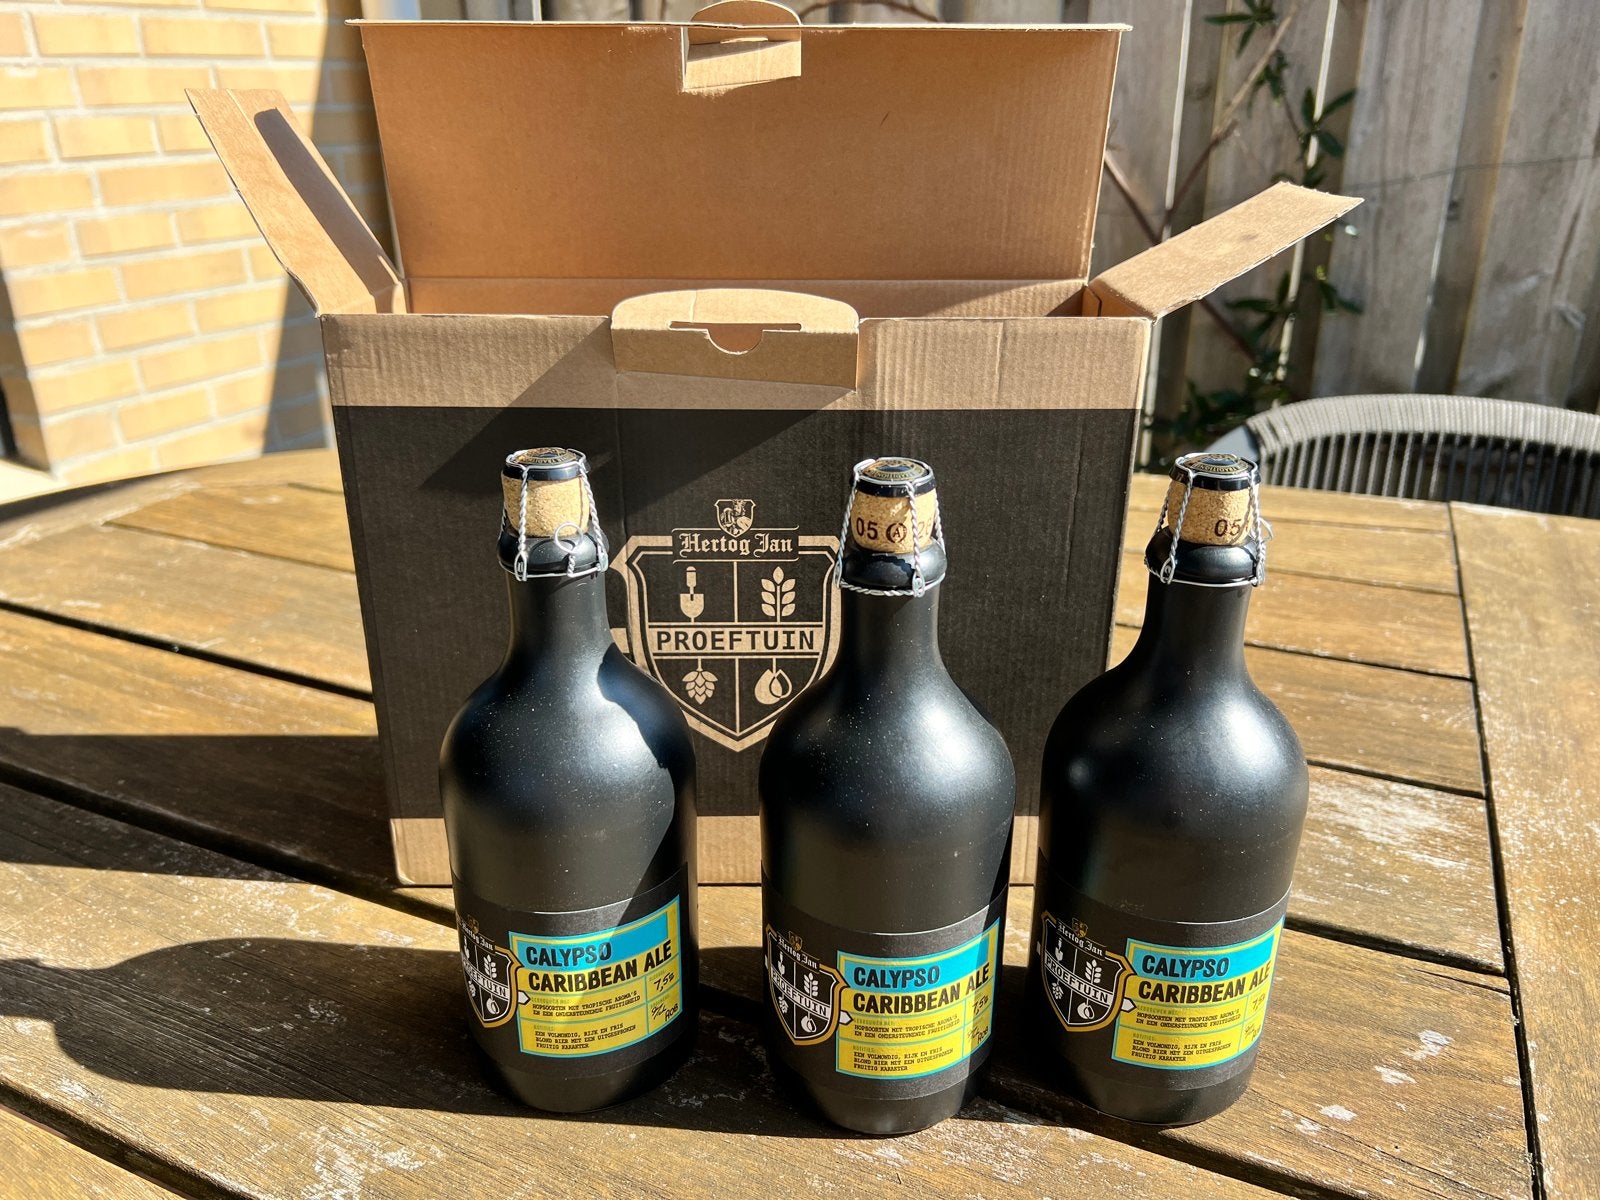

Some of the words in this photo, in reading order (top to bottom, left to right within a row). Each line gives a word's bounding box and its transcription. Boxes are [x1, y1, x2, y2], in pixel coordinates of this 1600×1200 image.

[856, 517, 878, 540] 05
[1214, 518, 1242, 537] 05
[679, 533, 751, 558] Hertog
[753, 533, 793, 558] Jan
[656, 630, 814, 651] PROEFTUIN
[525, 942, 612, 967] CALYPSO
[1084, 940, 1103, 956] Jan
[528, 959, 638, 993] CARIBBEAN
[643, 939, 672, 973] ALE
[853, 965, 940, 989] CALYPSO
[1141, 954, 1229, 979] CALYPSO
[853, 982, 960, 1014] CARIBBEAN
[965, 962, 990, 995] ALE
[1046, 955, 1108, 1003] PROEFTUIN
[1138, 977, 1246, 1004] CARIBBEAN
[1249, 960, 1271, 991] ALE
[582, 999, 613, 1010] TROPISCHE
[610, 1023, 624, 1032] FRIS
[854, 1024, 889, 1032] HOPSOORTEN
[905, 1022, 934, 1032] TROPISCHE
[1189, 1014, 1218, 1023] TROPISCHE
[1131, 1050, 1156, 1060] FRUITIG
[1132, 1045, 1150, 1053] BLOND
